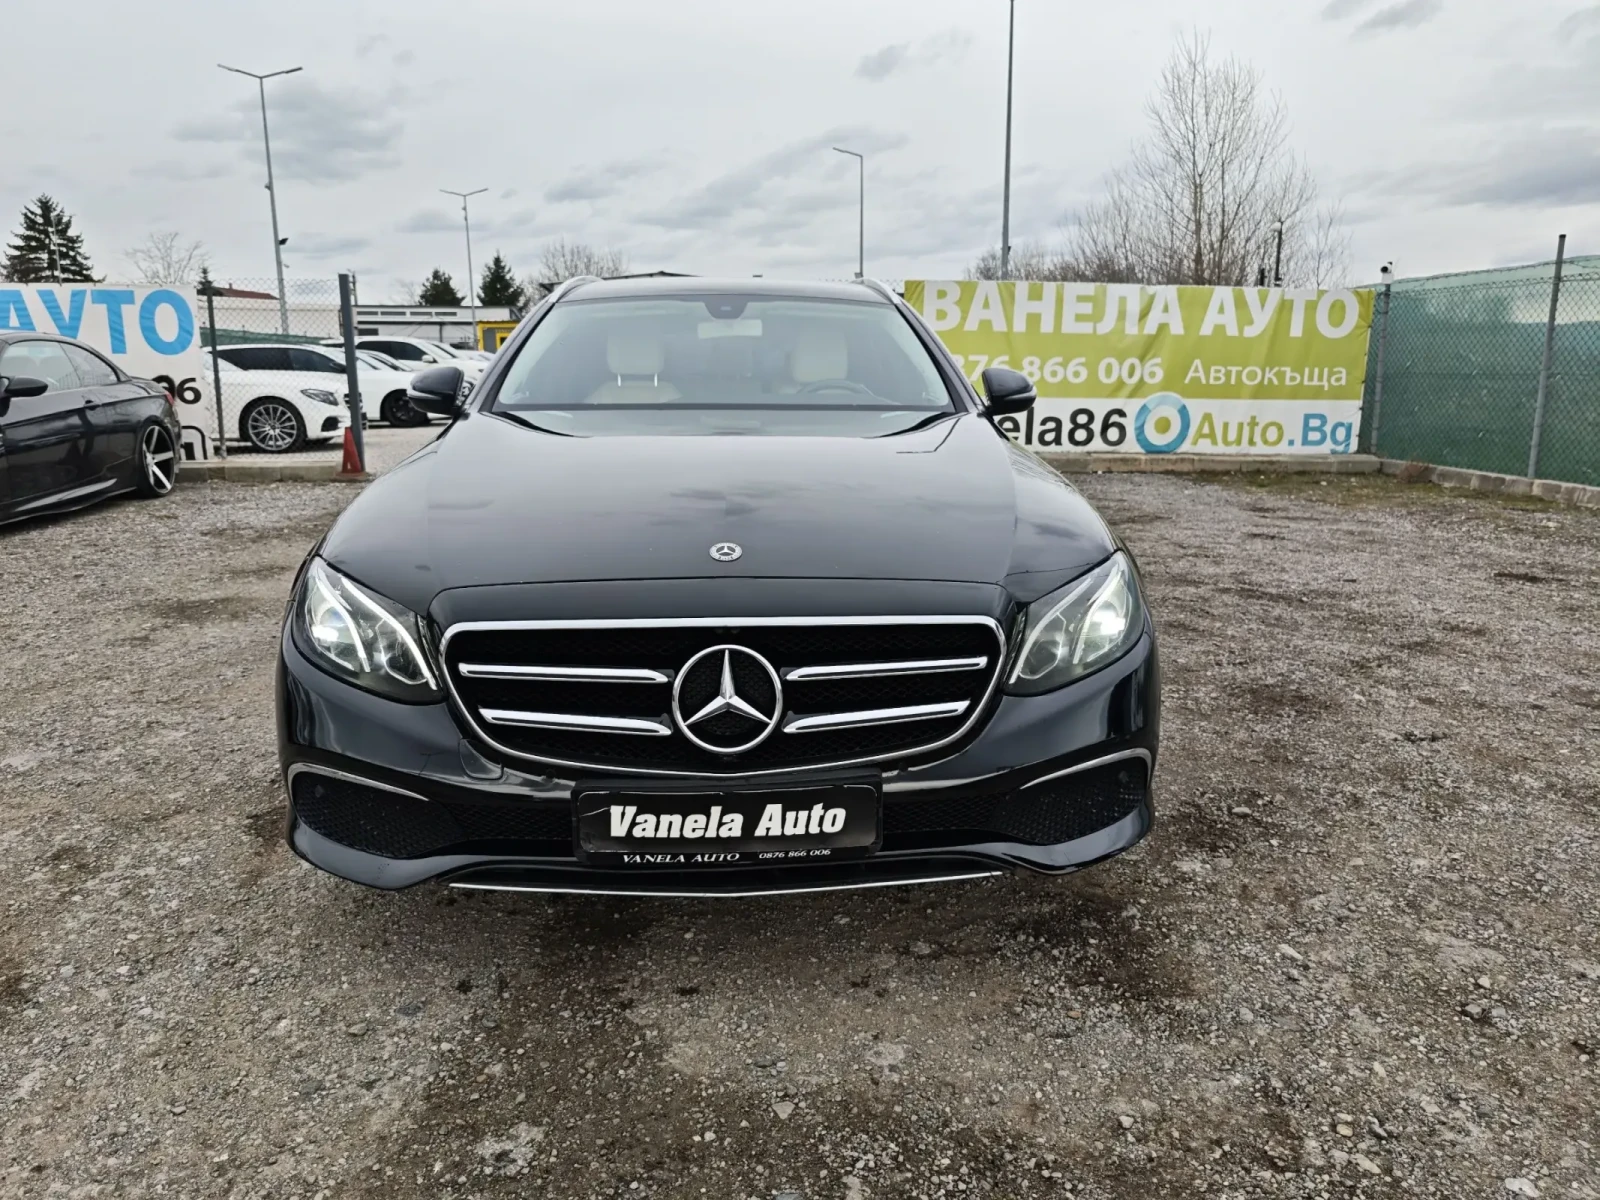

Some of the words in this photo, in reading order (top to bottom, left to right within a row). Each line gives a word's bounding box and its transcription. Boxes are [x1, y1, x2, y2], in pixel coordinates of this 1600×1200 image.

[922, 280, 1185, 336] ВАНЕЛА
[1199, 286, 1360, 339] АУТО
[1021, 356, 1088, 384] 866
[1098, 357, 1165, 385] 006
[1184, 358, 1348, 390] Автокъща
[1190, 412, 1353, 455] Auto.Bg
[610, 805, 744, 838] Vanela
[754, 803, 847, 836] Auto
[623, 854, 685, 863] VANELA
[691, 853, 740, 862] AUTO
[758, 851, 785, 859] 0876
